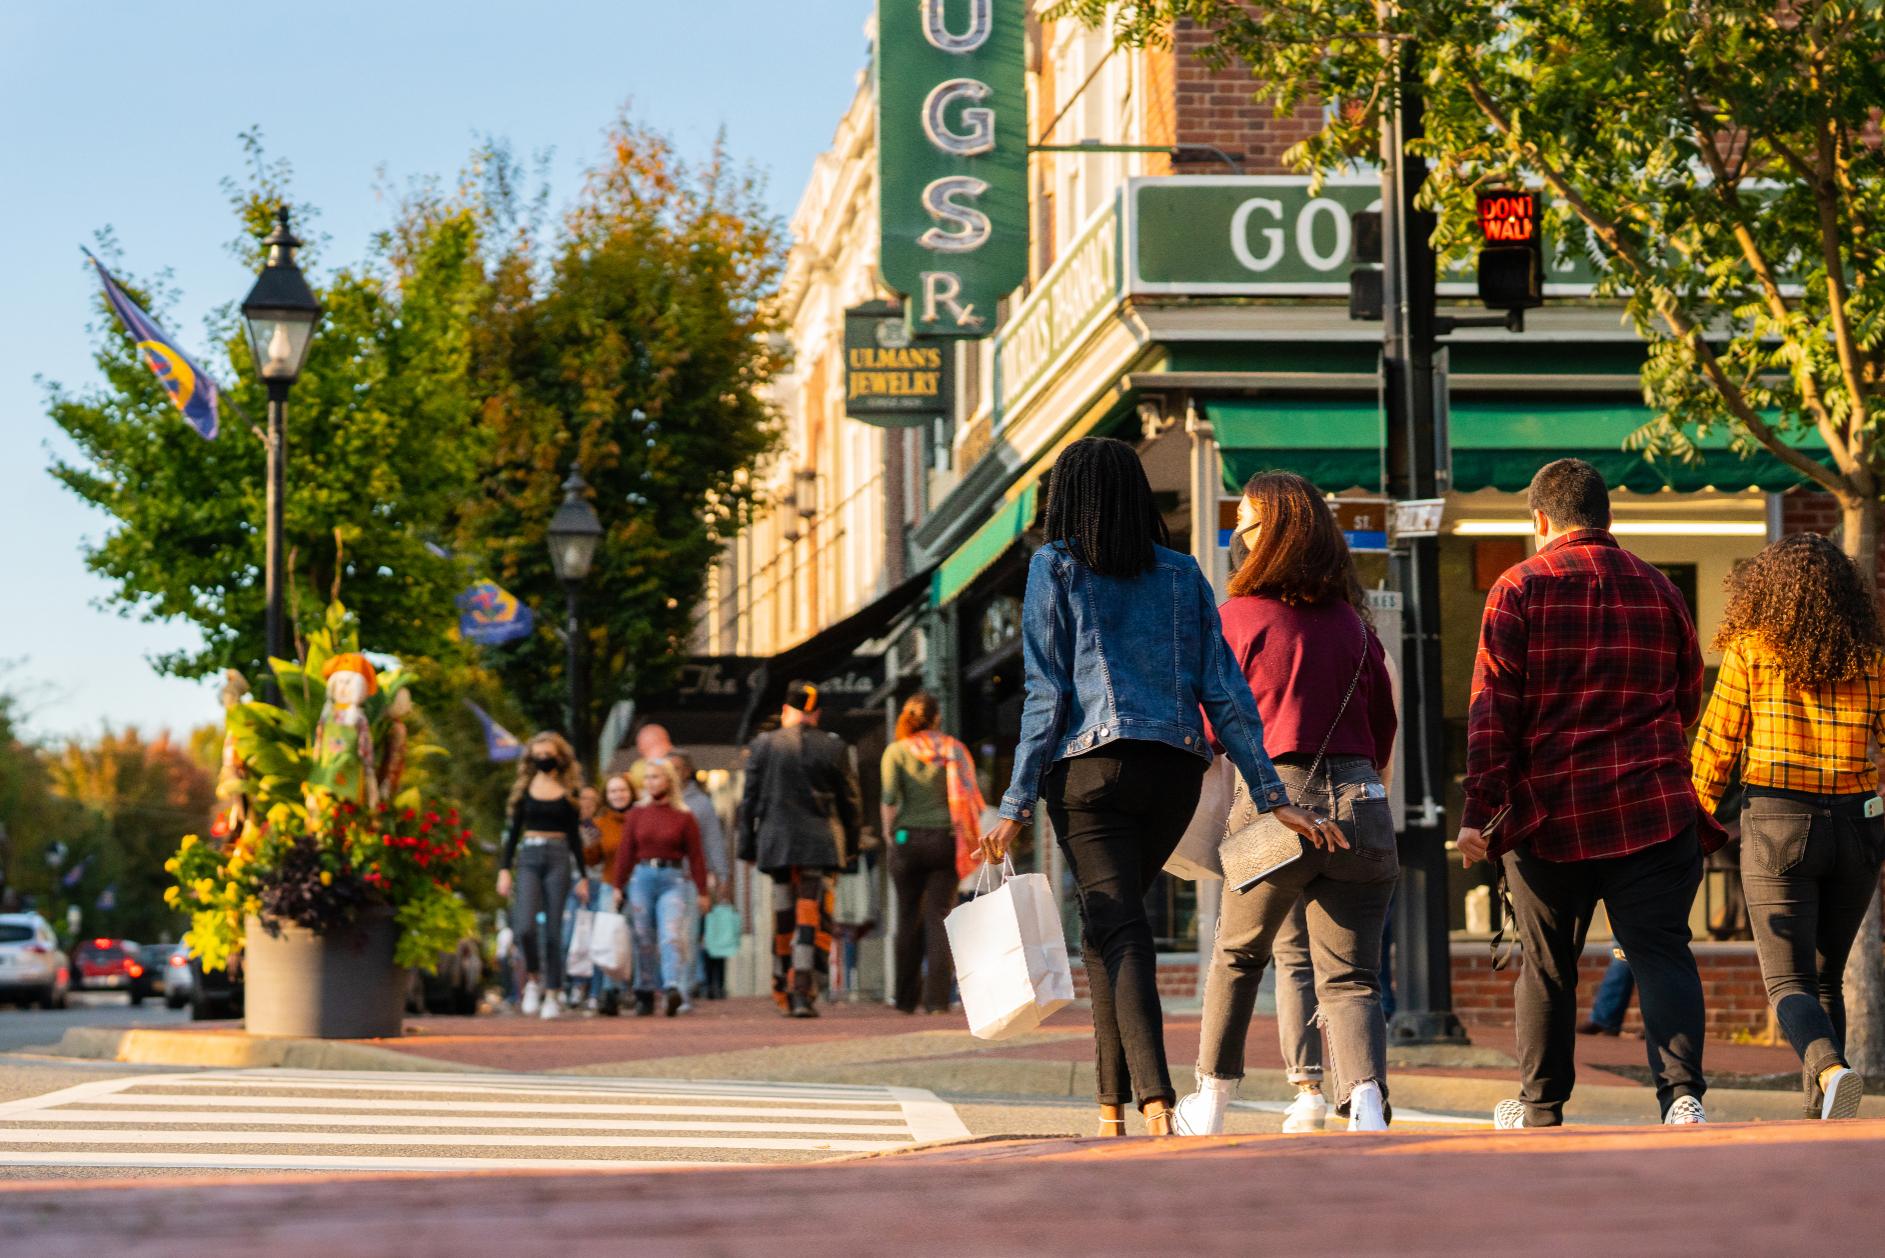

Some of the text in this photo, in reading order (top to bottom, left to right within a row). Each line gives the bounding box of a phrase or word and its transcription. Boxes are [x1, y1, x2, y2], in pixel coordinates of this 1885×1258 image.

[1230, 197, 1382, 272] GO
[850, 347, 942, 369] ULMAN'S
[848, 370, 941, 400] JEWELRY
